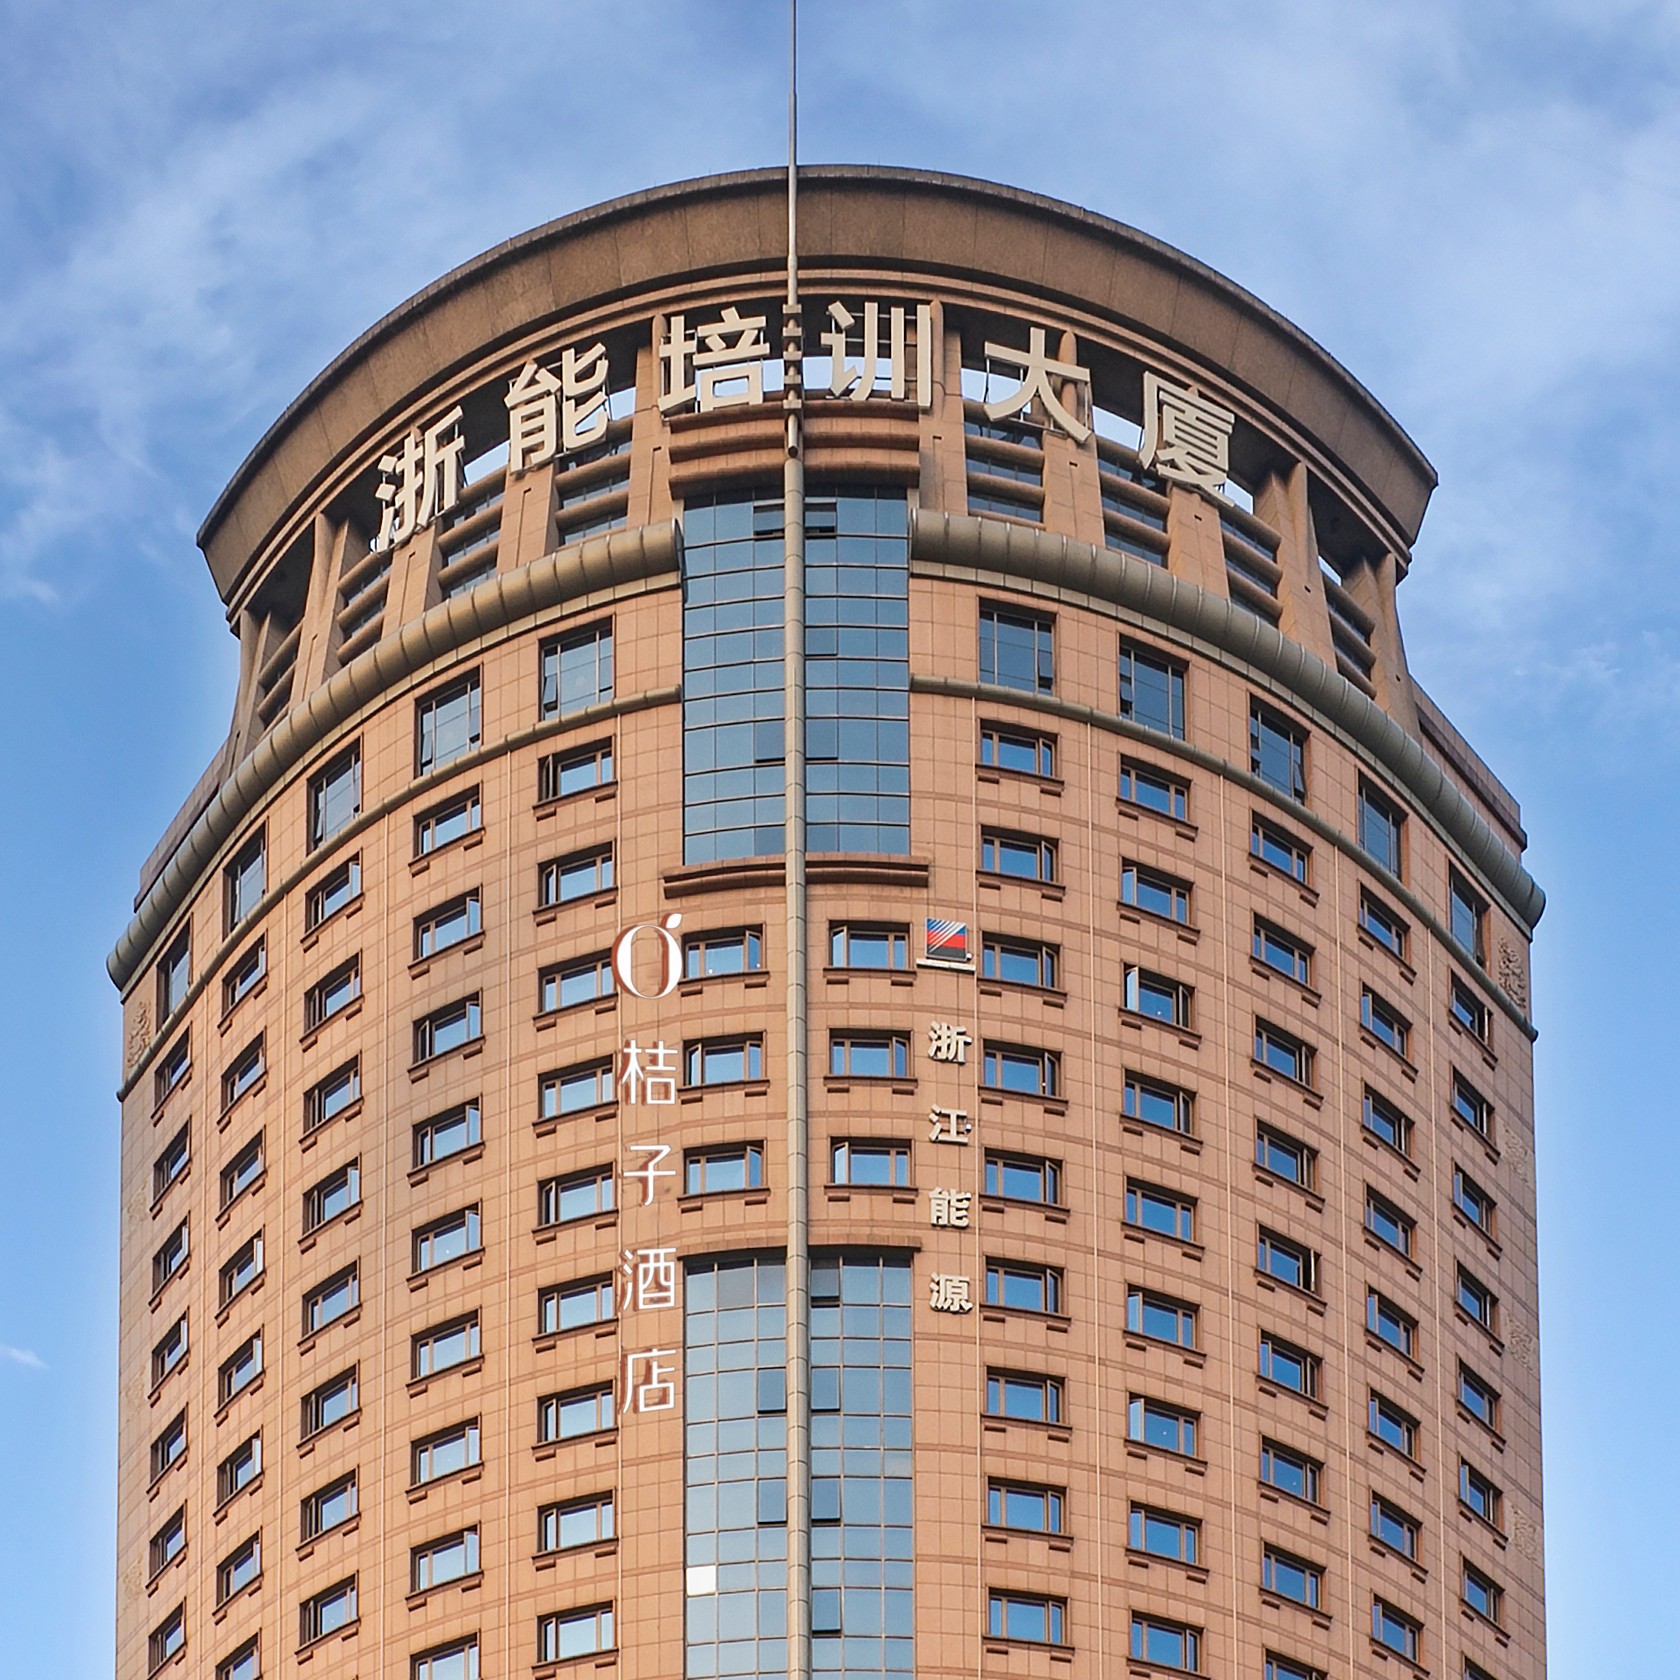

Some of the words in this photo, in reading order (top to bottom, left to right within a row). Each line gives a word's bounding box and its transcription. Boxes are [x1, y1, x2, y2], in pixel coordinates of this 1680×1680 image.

[374, 301, 1240, 555] 浙能培训大厦
[620, 1040, 679, 1415] 桔子酒店
[928, 1020, 973, 1314] 浙江能源
